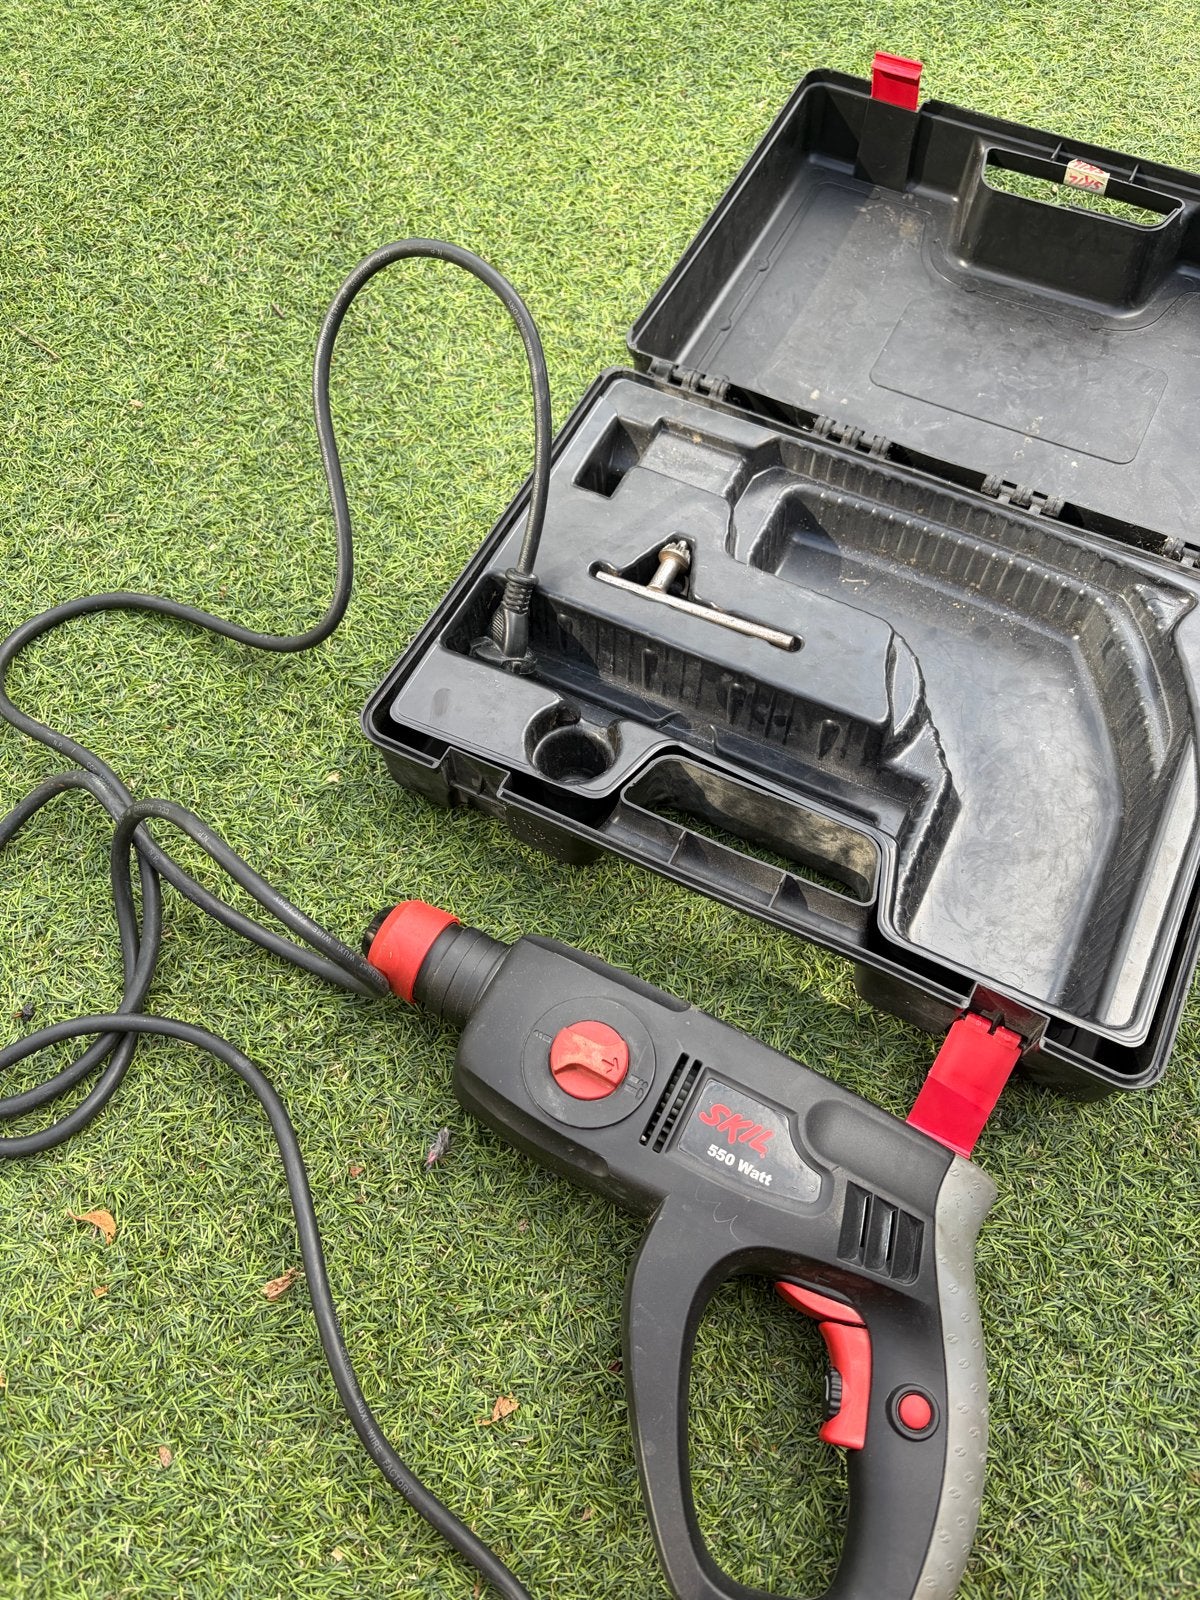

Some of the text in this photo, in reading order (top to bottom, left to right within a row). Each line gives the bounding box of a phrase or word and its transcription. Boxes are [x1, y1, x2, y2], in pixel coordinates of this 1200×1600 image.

[506, 299, 528, 335] FACTORY
[274, 896, 308, 925] FACTORY
[311, 925, 332, 944] WIRE
[336, 944, 356, 962] WUXI
[698, 1103, 774, 1155] SKIL
[707, 1143, 774, 1187] 550 Watt
[366, 1428, 384, 1455] WIRE
[382, 1459, 414, 1497] FACTORY
